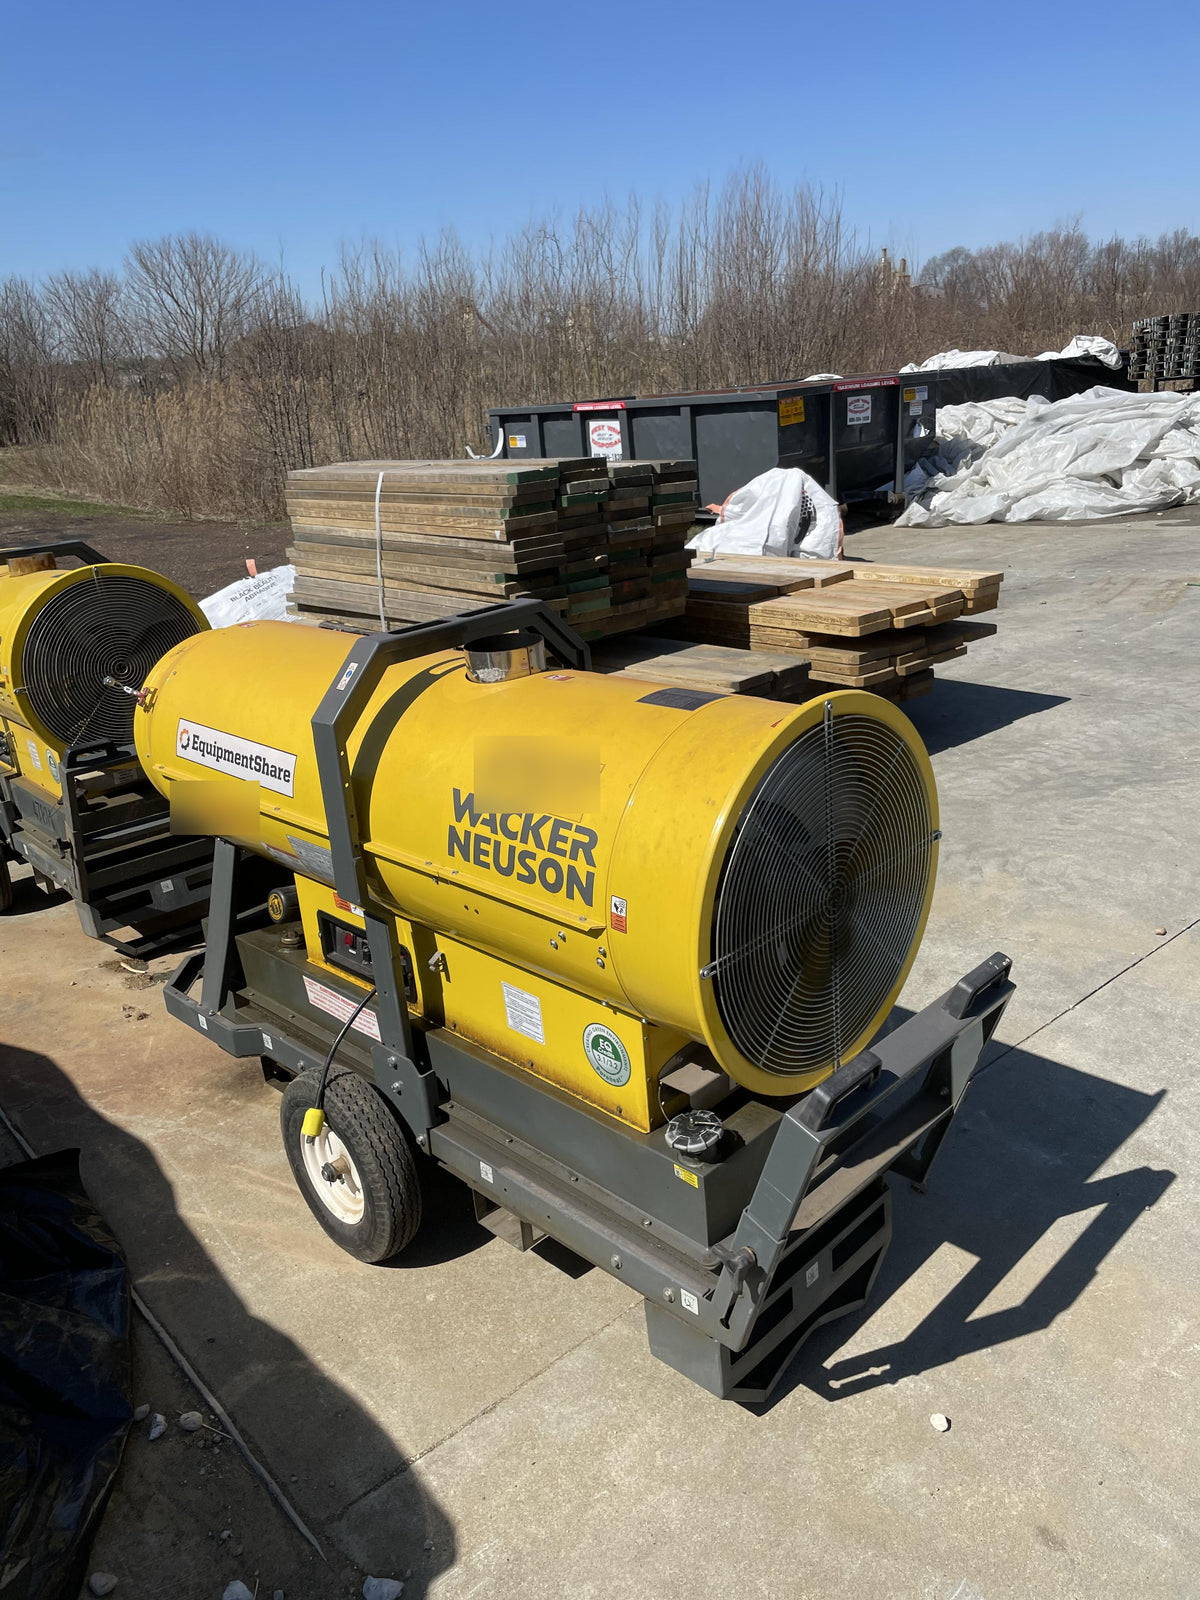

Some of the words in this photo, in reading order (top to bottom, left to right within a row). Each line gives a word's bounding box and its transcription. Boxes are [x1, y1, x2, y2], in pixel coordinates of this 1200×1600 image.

[230, 588, 253, 603] BLACK
[191, 734, 291, 783] EquipmentShare
[453, 788, 598, 867] WACKER
[448, 825, 595, 907] NEUSON
[599, 1038, 613, 1052] EQ
